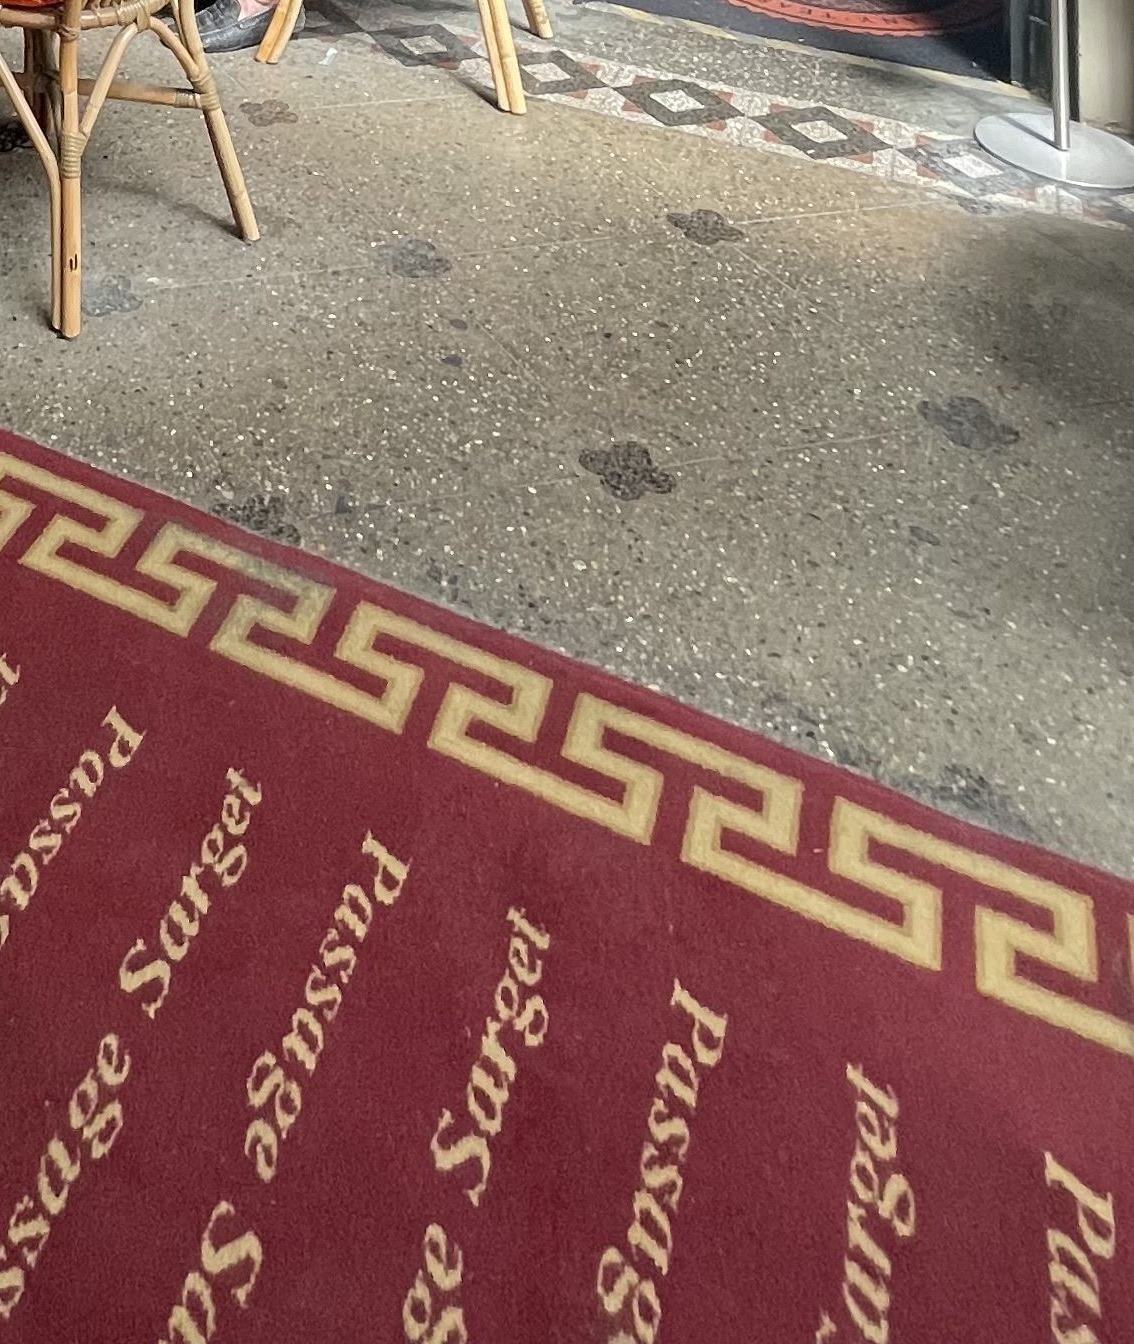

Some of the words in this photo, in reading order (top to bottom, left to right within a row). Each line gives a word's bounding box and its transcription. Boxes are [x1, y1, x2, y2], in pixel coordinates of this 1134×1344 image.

[118, 767, 262, 1019] Sarget
[244, 830, 410, 1183] Passage
[430, 906, 552, 1207] Sarget
[595, 977, 728, 1344] Passag
